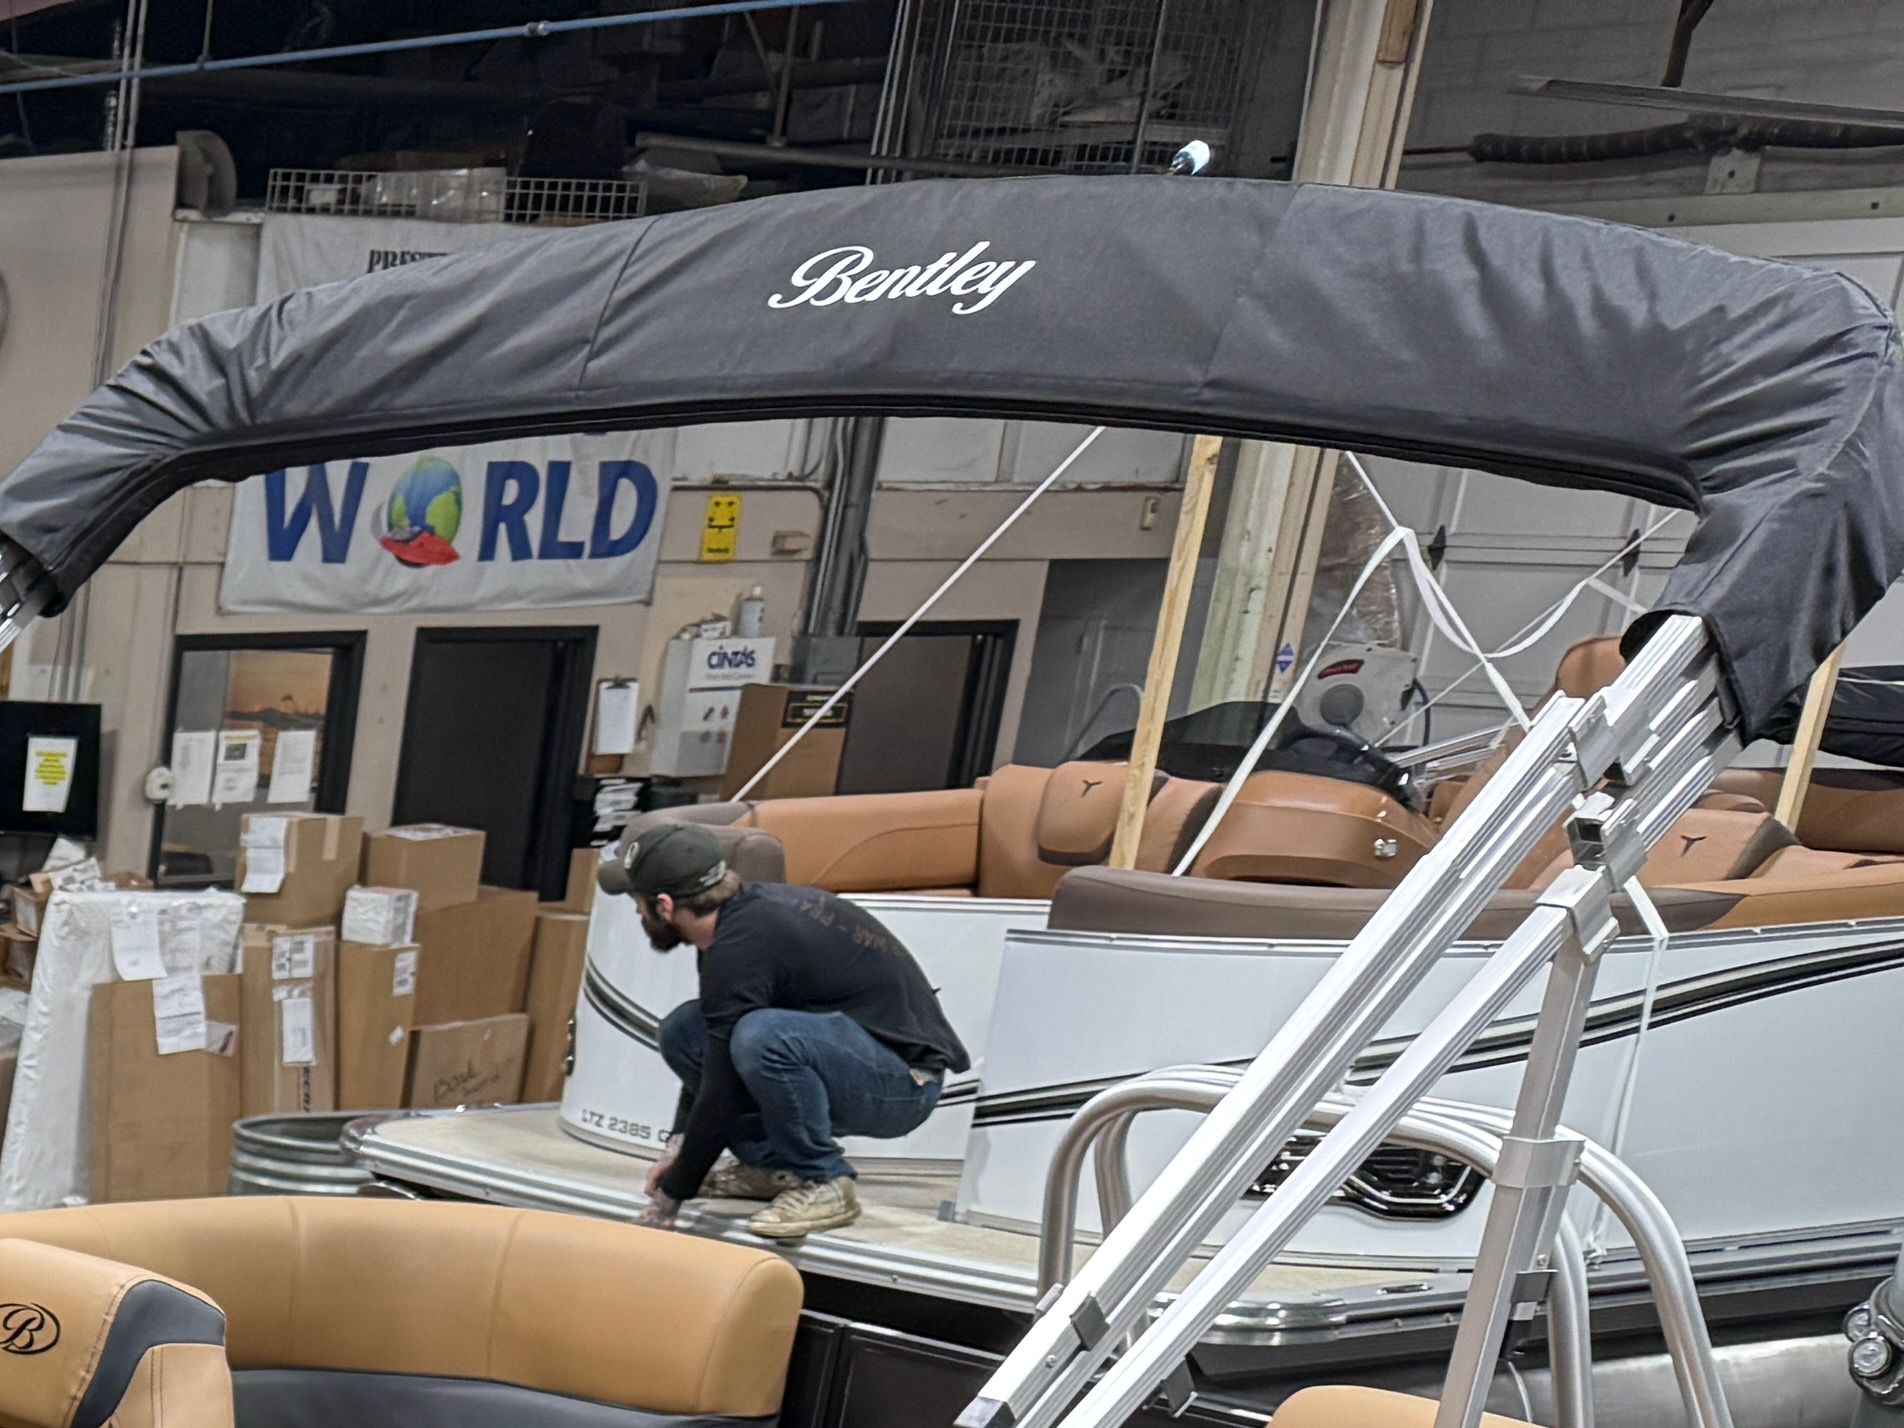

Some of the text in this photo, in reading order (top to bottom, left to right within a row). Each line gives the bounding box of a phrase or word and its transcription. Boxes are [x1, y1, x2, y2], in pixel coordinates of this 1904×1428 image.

[768, 241, 1036, 315] Bentley
[706, 645, 756, 670] CINTAS
[607, 1116, 652, 1140] 2385
